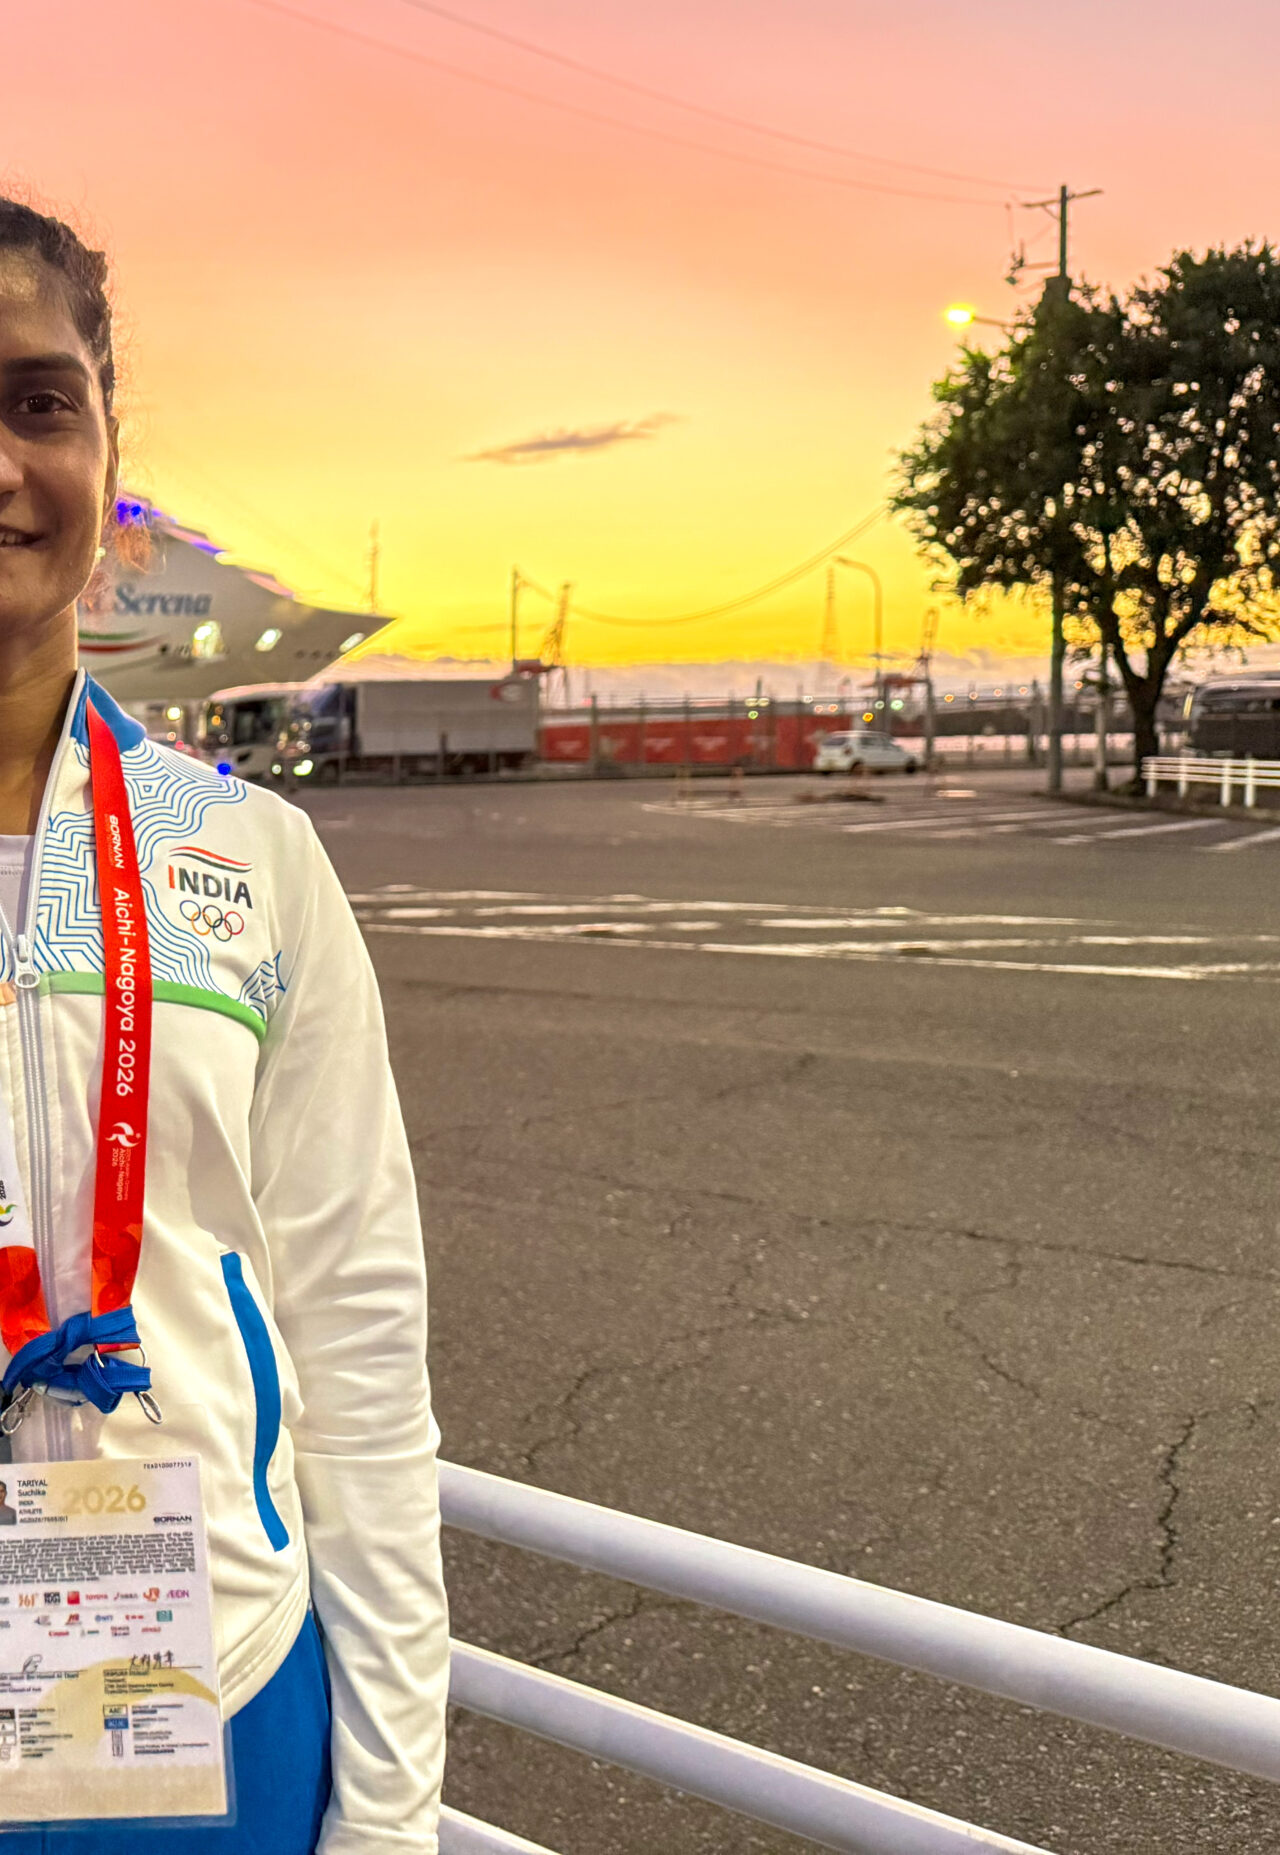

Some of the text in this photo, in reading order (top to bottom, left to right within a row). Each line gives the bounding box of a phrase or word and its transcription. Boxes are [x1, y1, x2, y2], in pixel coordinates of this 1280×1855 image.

[115, 582, 213, 616] Serena
[109, 814, 125, 869] BORNAN
[168, 864, 253, 910] INDIA
[113, 887, 137, 1097] Aichi-Nagoya 2026
[17, 1479, 48, 1488] TARIYAL
[17, 1488, 47, 1497] Suchika
[62, 1484, 146, 1516] 2026
